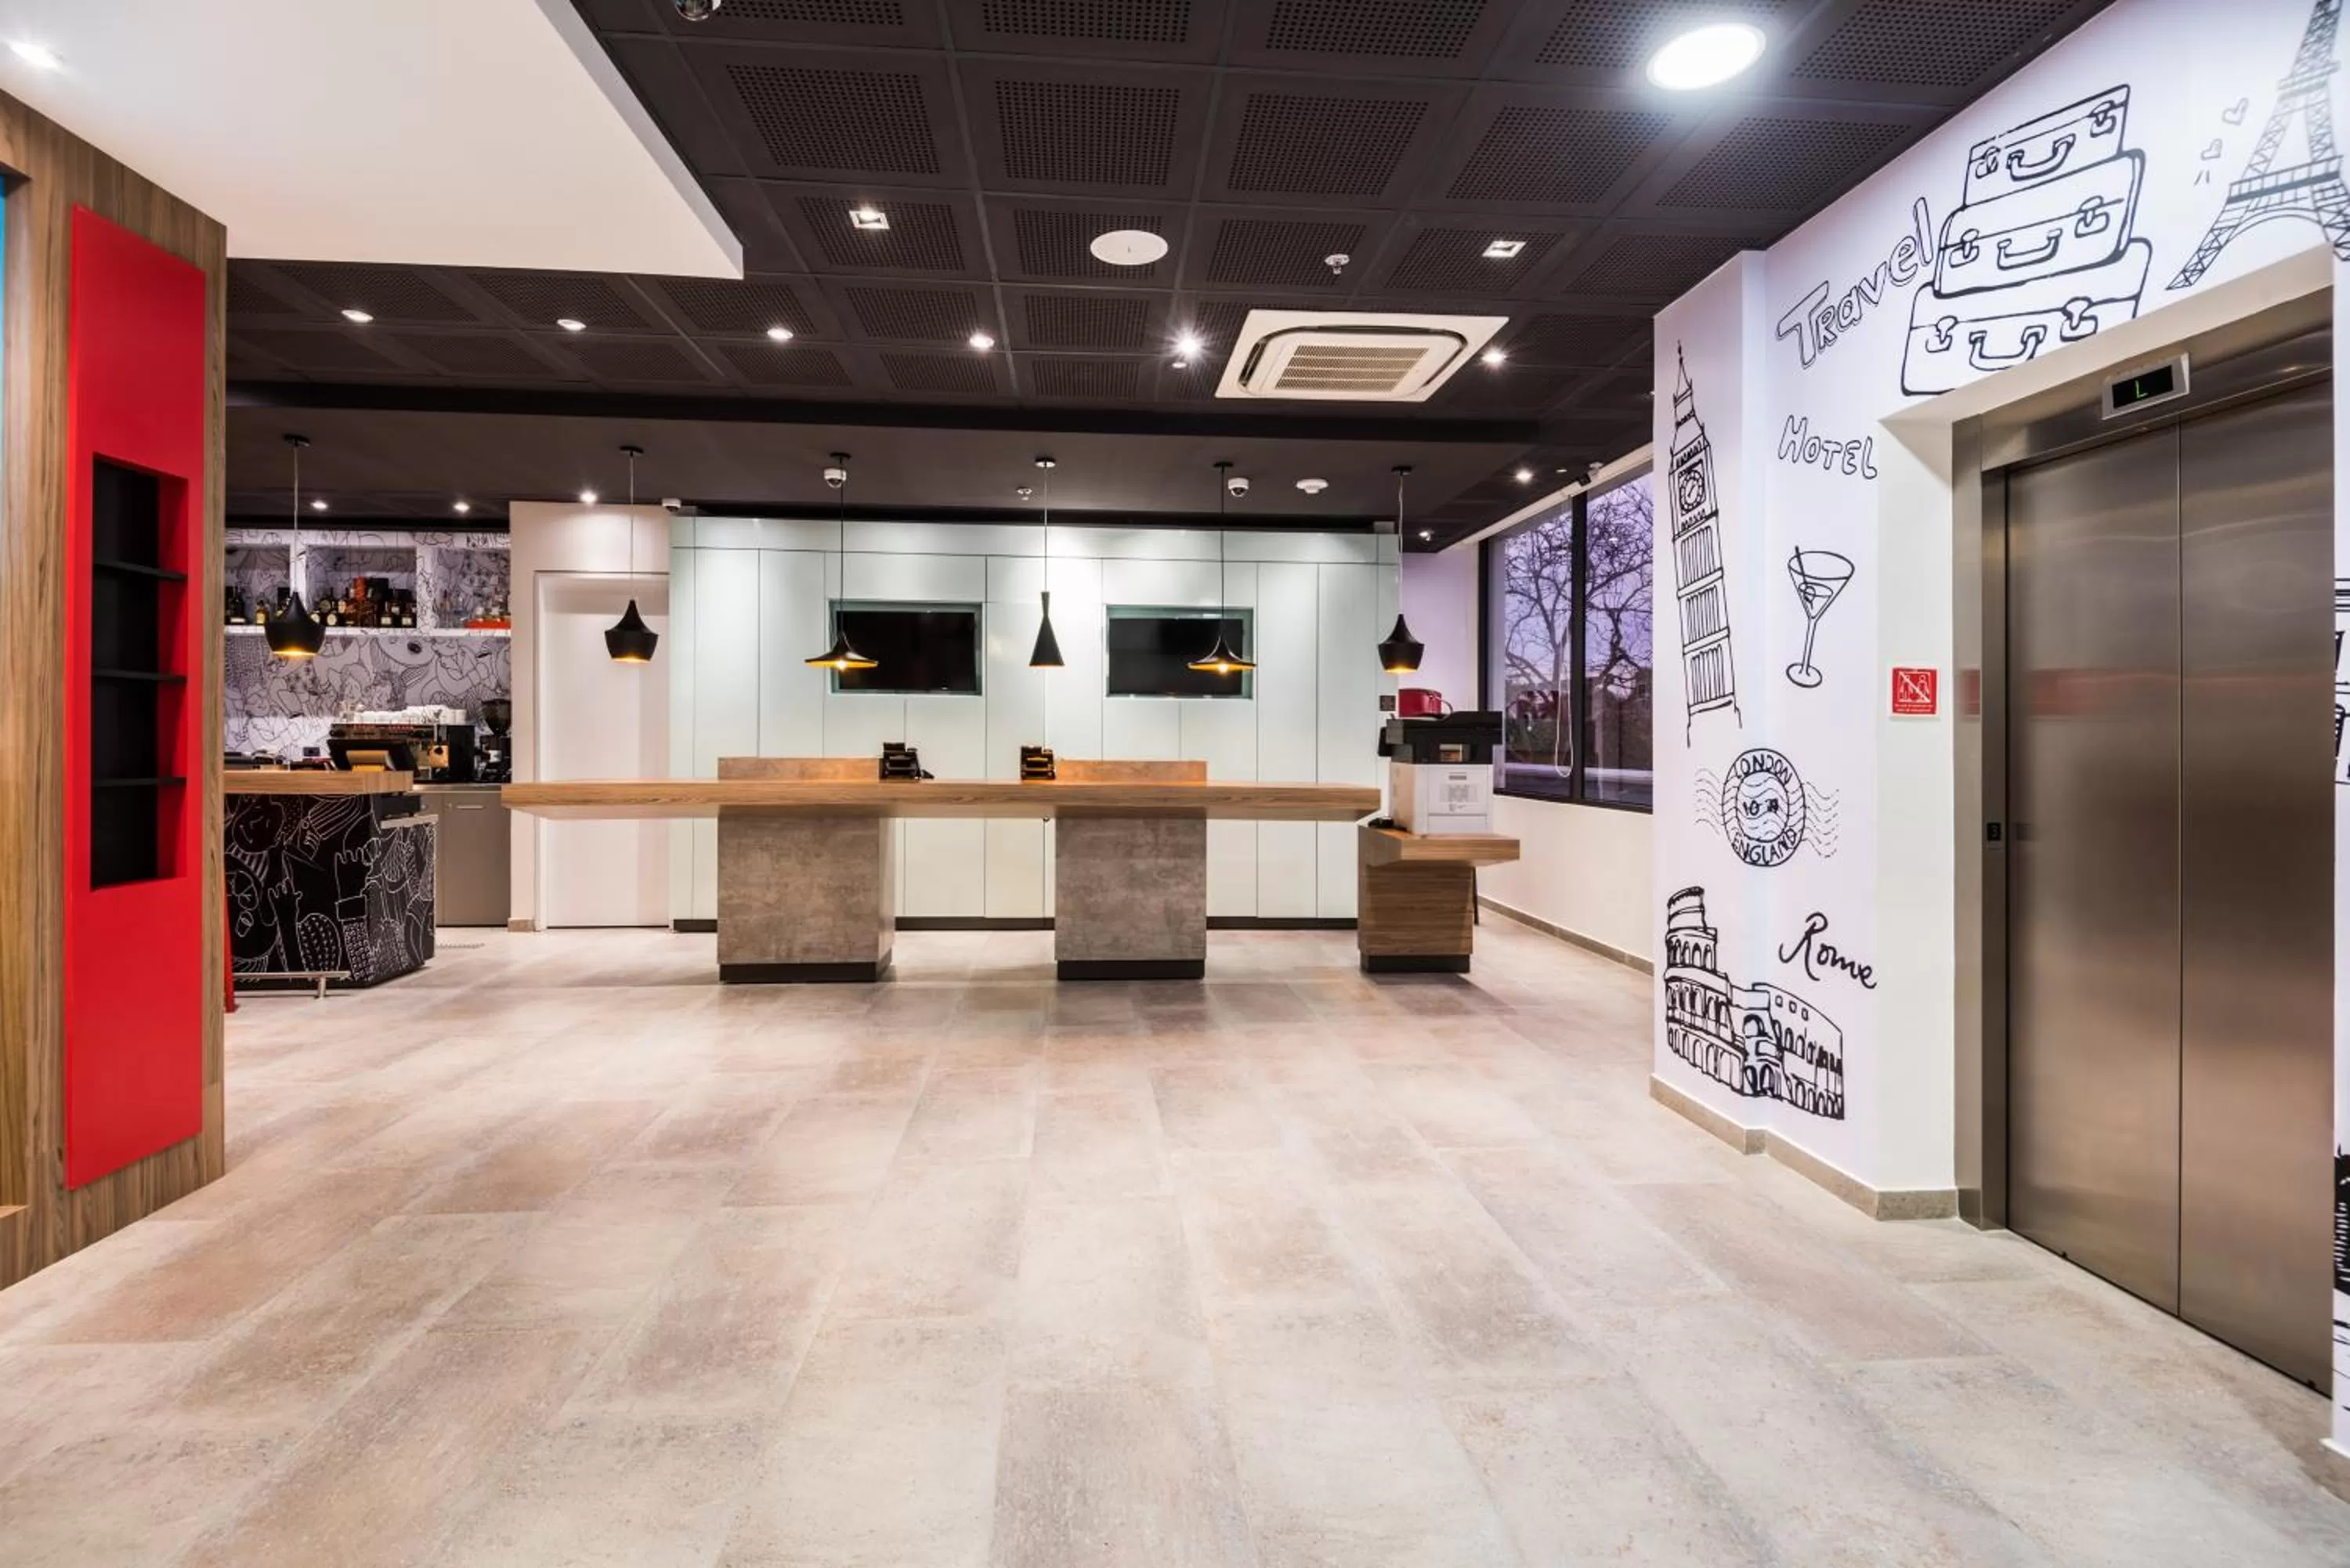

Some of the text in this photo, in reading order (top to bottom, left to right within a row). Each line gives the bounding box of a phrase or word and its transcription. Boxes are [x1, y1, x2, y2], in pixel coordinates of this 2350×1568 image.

[1776, 197, 1934, 369] Travel
[2135, 380, 2149, 399] L
[1777, 414, 1878, 479] HOTEL
[1734, 753, 1793, 785] LONDON
[1732, 827, 1798, 865] ENGLAND
[1778, 912, 1878, 989] Rome
